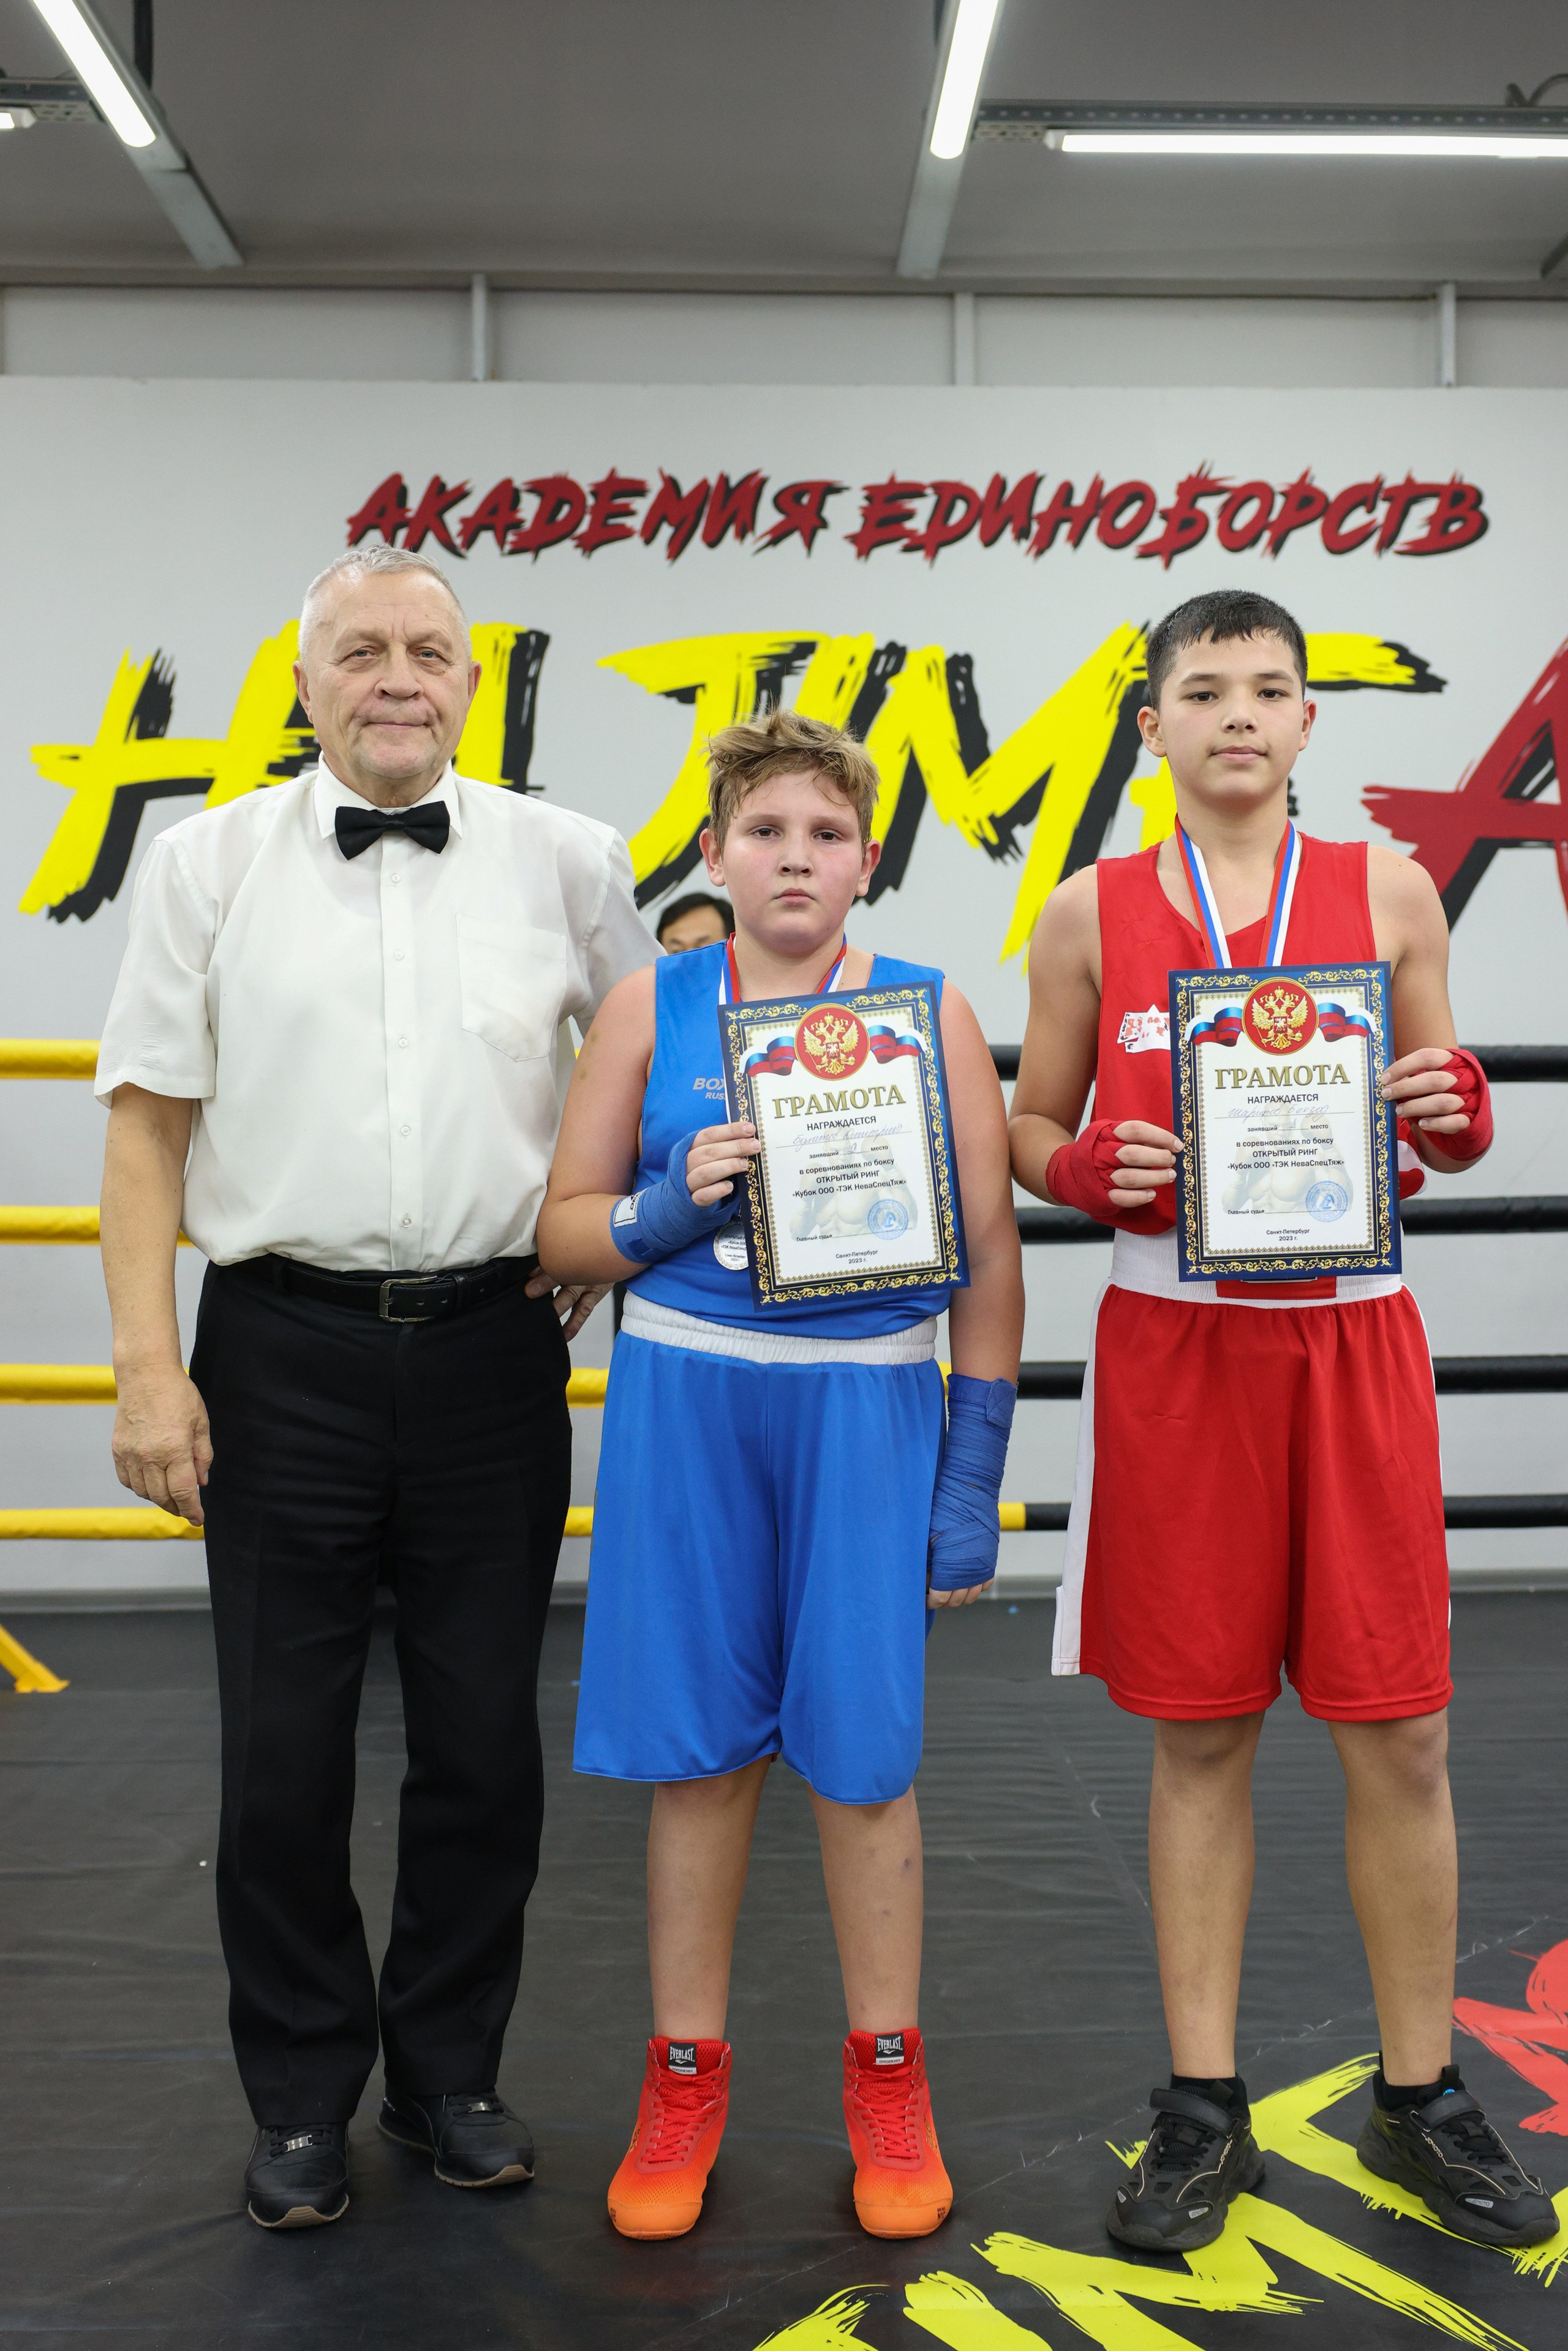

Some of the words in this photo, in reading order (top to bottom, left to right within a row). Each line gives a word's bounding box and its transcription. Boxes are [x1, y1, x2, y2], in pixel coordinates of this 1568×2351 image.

[347, 466, 850, 564] АКАДЕМИЯ
[845, 461, 1489, 572] ЕДИНОБОРСТВ
[1215, 1063, 1351, 1090] ГРАМОТА
[705, 1092, 725, 1100] RUS
[772, 1084, 906, 1119] ГРАМОТА
[1248, 1093, 1319, 1104] НАГРАЖДАЕТСЯ
[807, 1116, 876, 1131] НАГРАЖДАЕТСЯ
[1243, 1139, 1300, 1148] соревнованиях
[809, 1150, 839, 1159] занявший
[1253, 1148, 1296, 1158] ОТКРЫТЫЙ
[805, 1162, 862, 1175] соревнованиях
[816, 1172, 859, 1184] ОТКРЫТЫЙ
[861, 1170, 880, 1179] РИНГ
[835, 1249, 878, 1259] Санкт-Петербург
[876, 2036, 901, 2052] EVERLAST
[669, 2046, 694, 2062] EVERLAST
